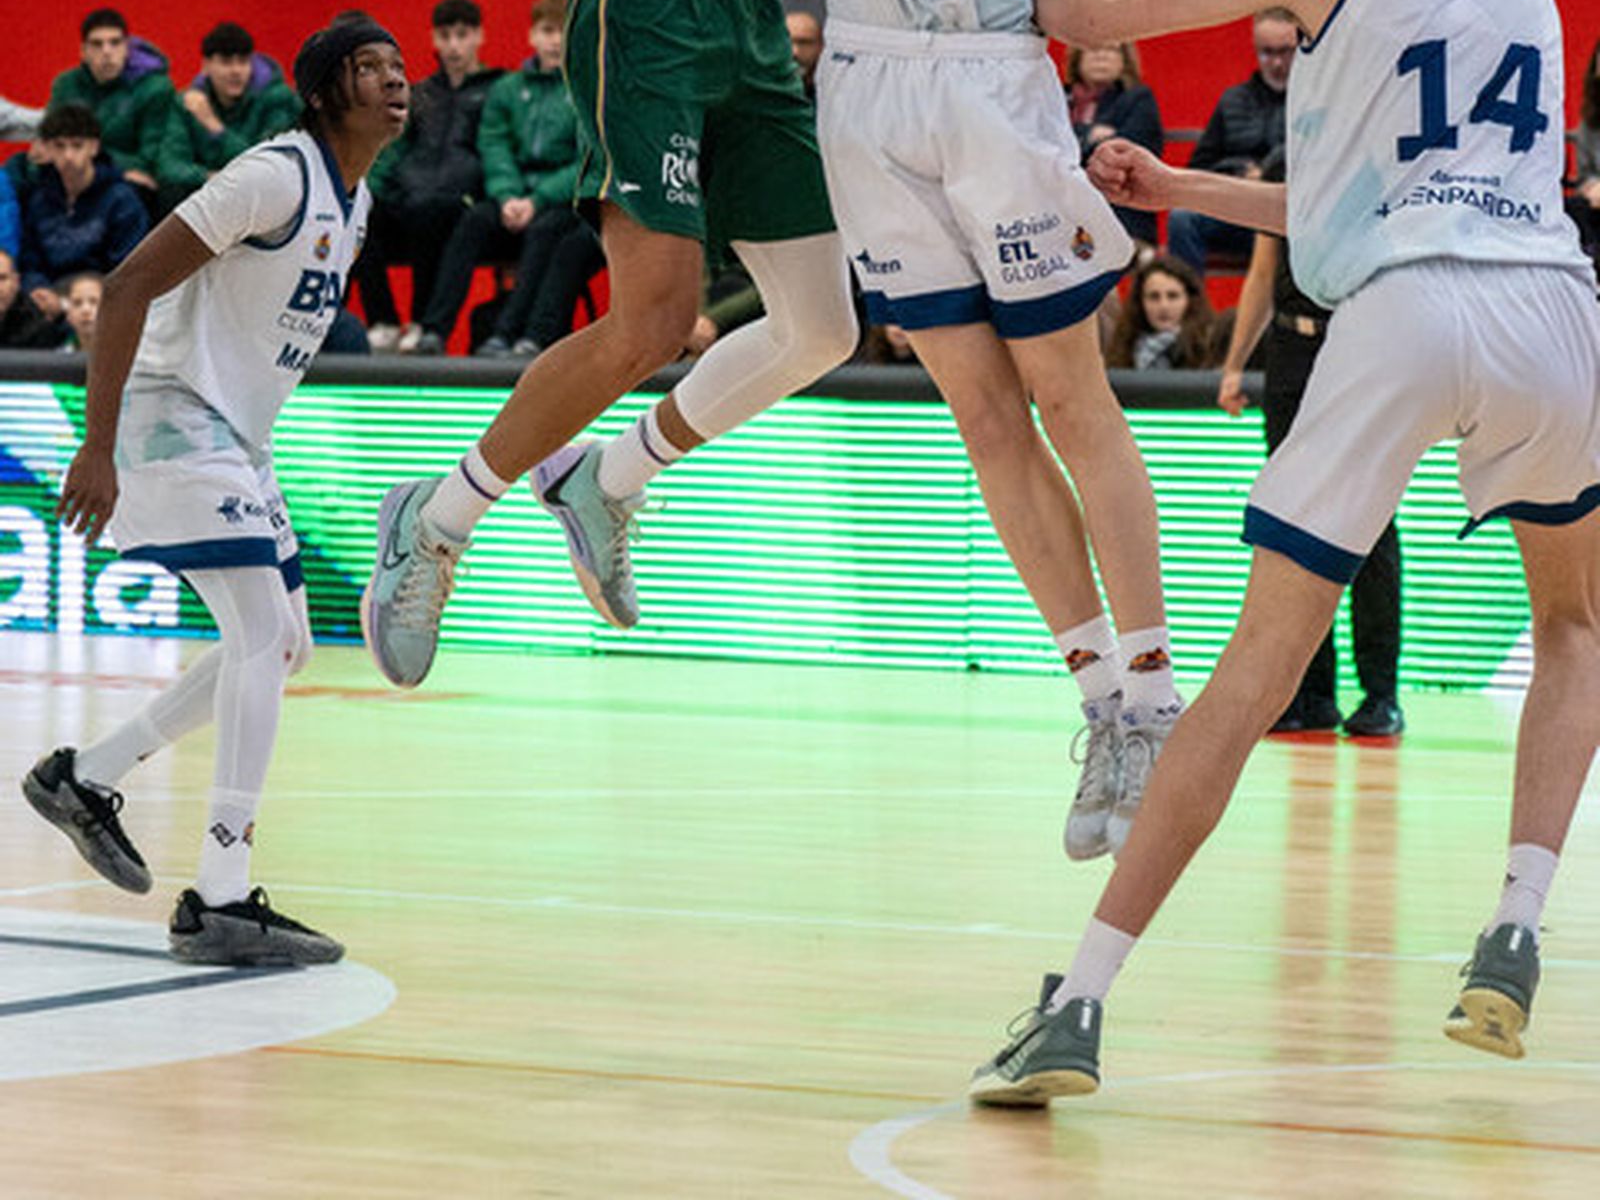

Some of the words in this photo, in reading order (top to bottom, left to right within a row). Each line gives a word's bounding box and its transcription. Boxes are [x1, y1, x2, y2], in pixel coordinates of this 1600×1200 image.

[1396, 37, 1549, 162] 14
[999, 239, 1038, 264] ETL
[1001, 254, 1071, 284] GLOBAL
